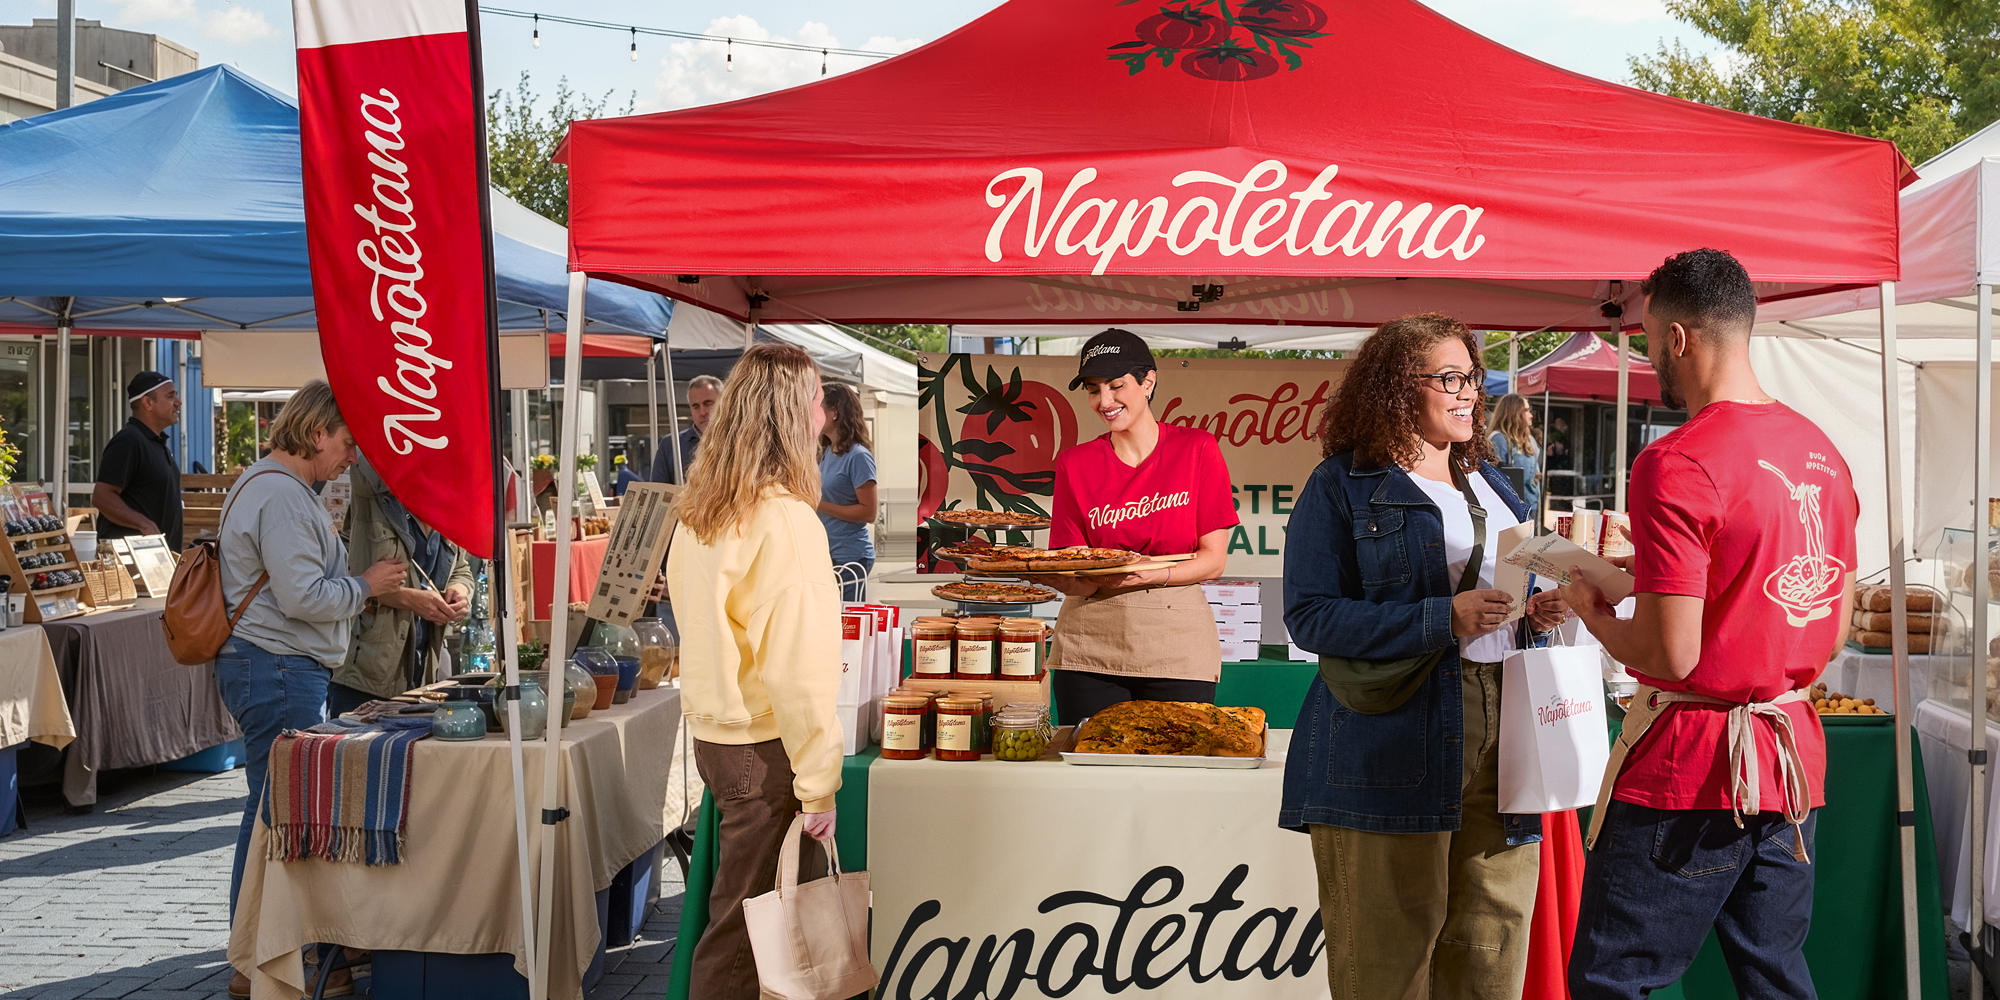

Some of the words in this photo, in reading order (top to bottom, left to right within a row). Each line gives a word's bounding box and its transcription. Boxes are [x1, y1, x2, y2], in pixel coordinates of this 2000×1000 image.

[985, 160, 1485, 275] Napoletana
[354, 88, 453, 455] Napoletana
[1806, 461, 1837, 479] APPETITO!
[1809, 451, 1826, 462] BUON
[1088, 491, 1190, 530] Napoletana
[1538, 698, 1592, 727] Napoletana
